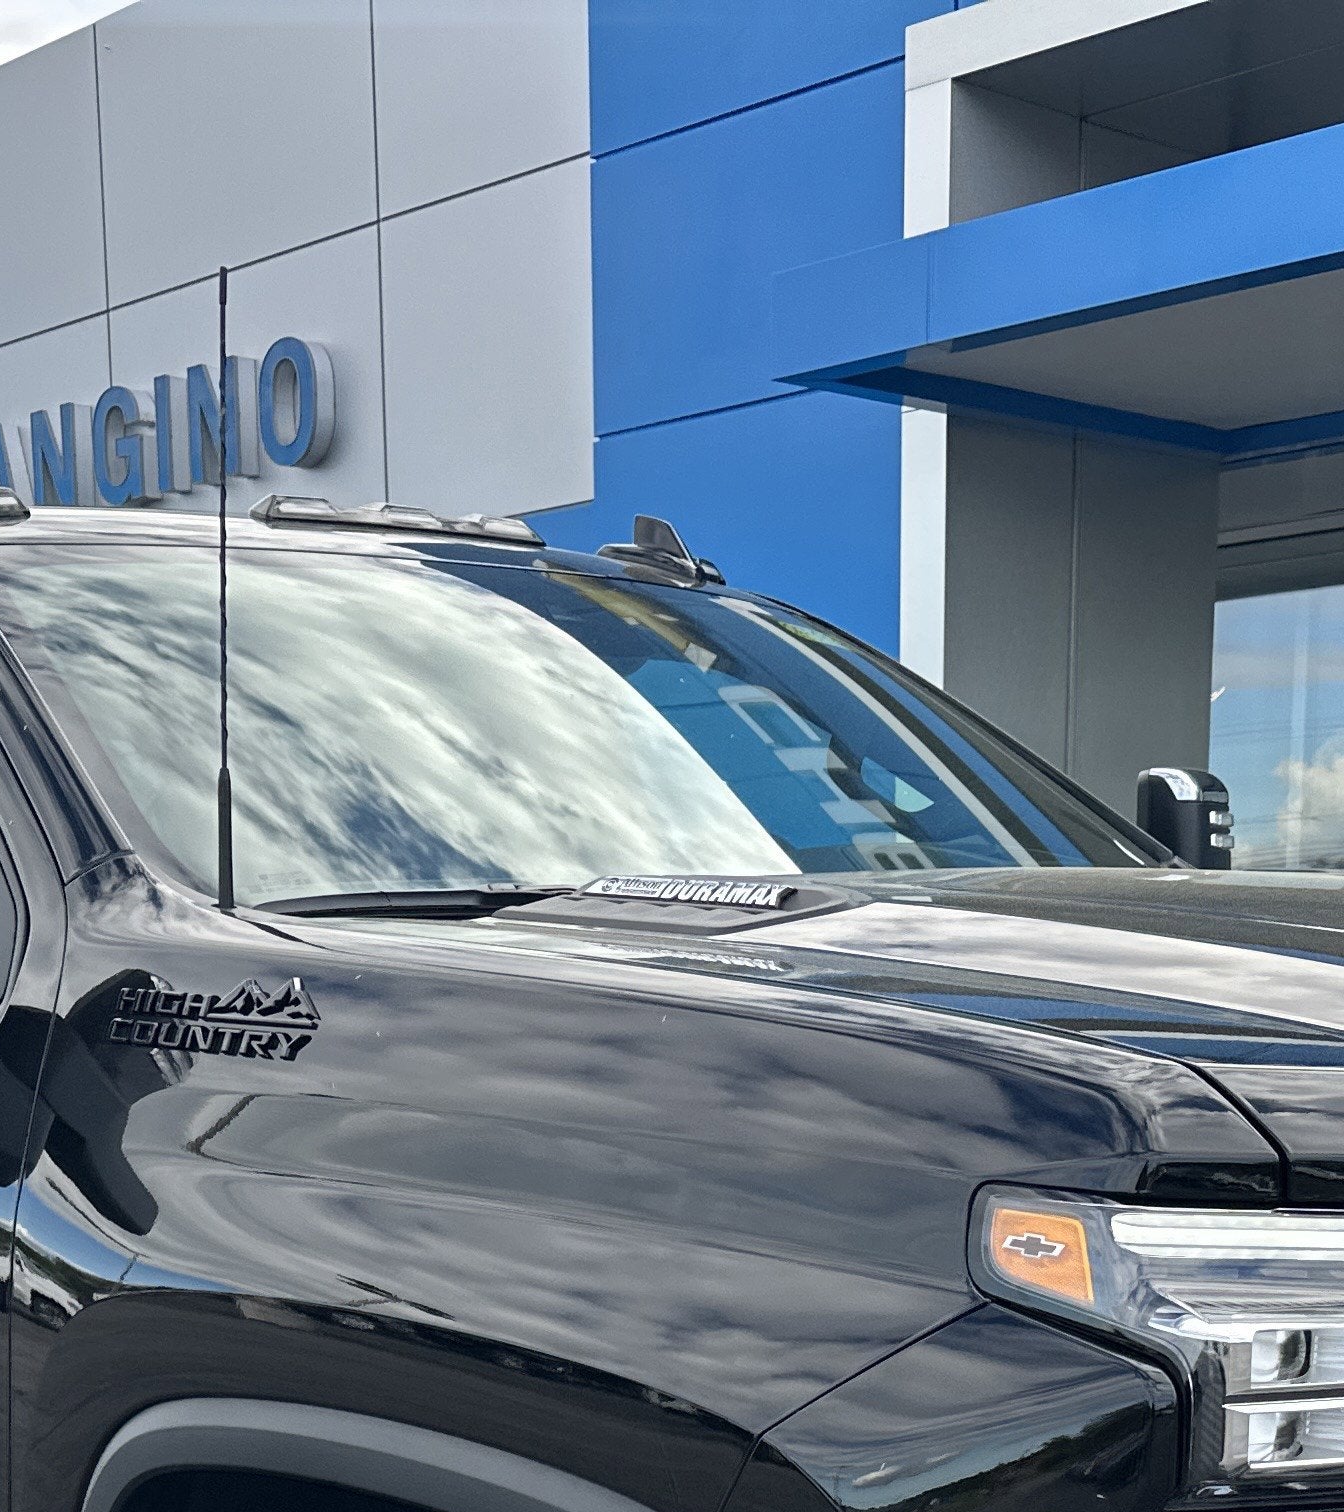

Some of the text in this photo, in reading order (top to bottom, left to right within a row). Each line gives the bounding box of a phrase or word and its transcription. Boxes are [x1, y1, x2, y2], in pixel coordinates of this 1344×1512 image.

[659, 879, 788, 906] DURAMAX
[117, 987, 215, 1018] HIGH
[110, 1017, 313, 1061] COUNTRY
